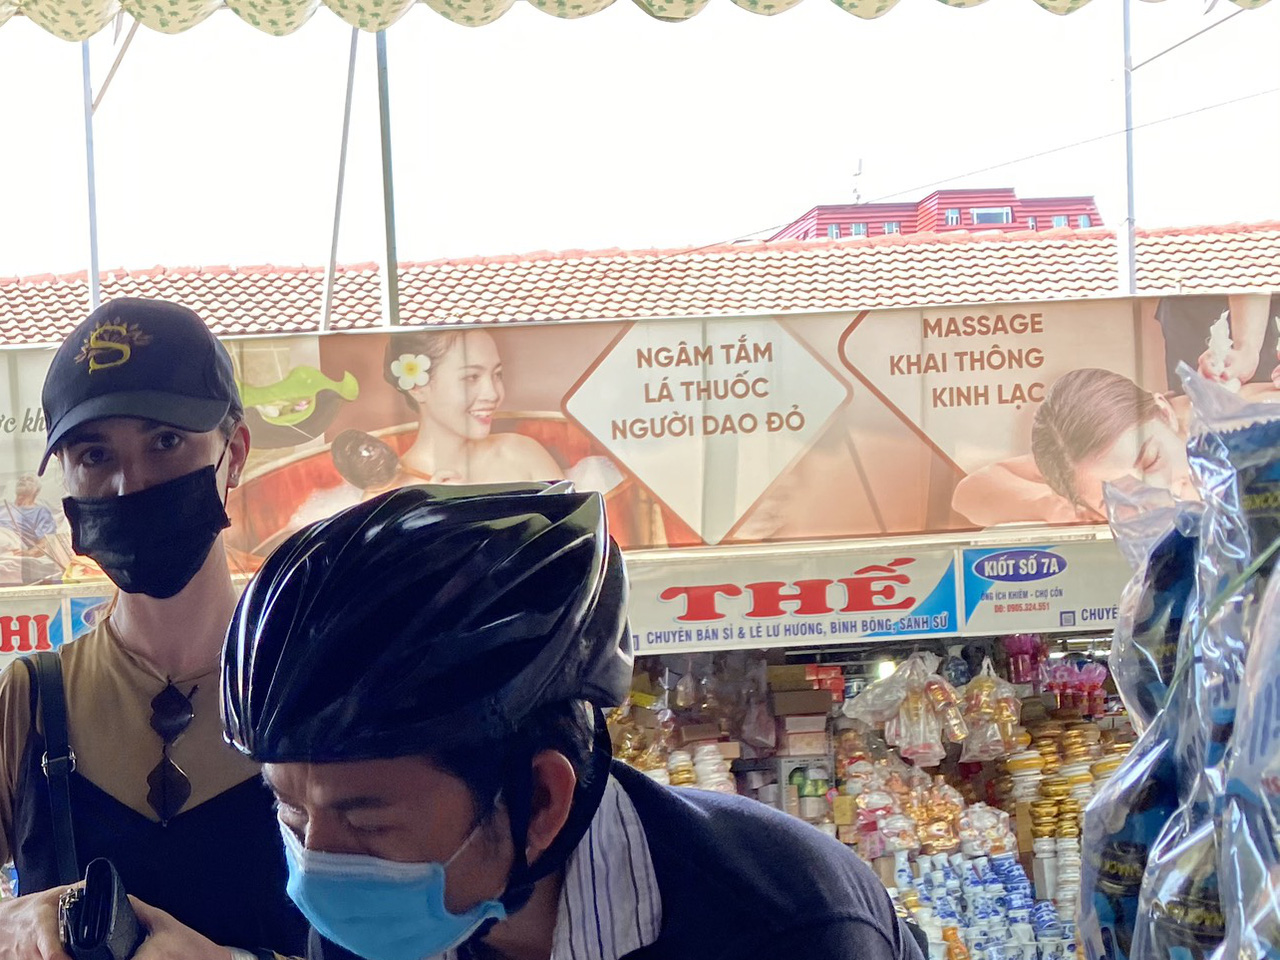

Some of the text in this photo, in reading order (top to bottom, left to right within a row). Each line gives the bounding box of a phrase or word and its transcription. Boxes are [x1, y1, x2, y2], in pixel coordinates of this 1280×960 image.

[923, 313, 1043, 338] MASSAGE
[636, 334, 773, 368] NGÂM TẮM
[890, 344, 1044, 375] KHAI THÔNG
[644, 370, 770, 403] LÁ THUỐC
[932, 382, 1045, 410] KINH LẠC
[611, 404, 805, 440] NGƯỜI DAO ĐỎ
[984, 553, 1060, 577] KIỐT SỐ 7A
[659, 557, 917, 621] THẾ
[646, 627, 692, 644] CHUYÊN
[697, 626, 718, 641] BÁN
[723, 624, 734, 640] SỈ
[738, 627, 746, 639] &
[750, 622, 762, 638] LẺ
[830, 619, 857, 634] BÌNH
[933, 612, 948, 628] SỨ
